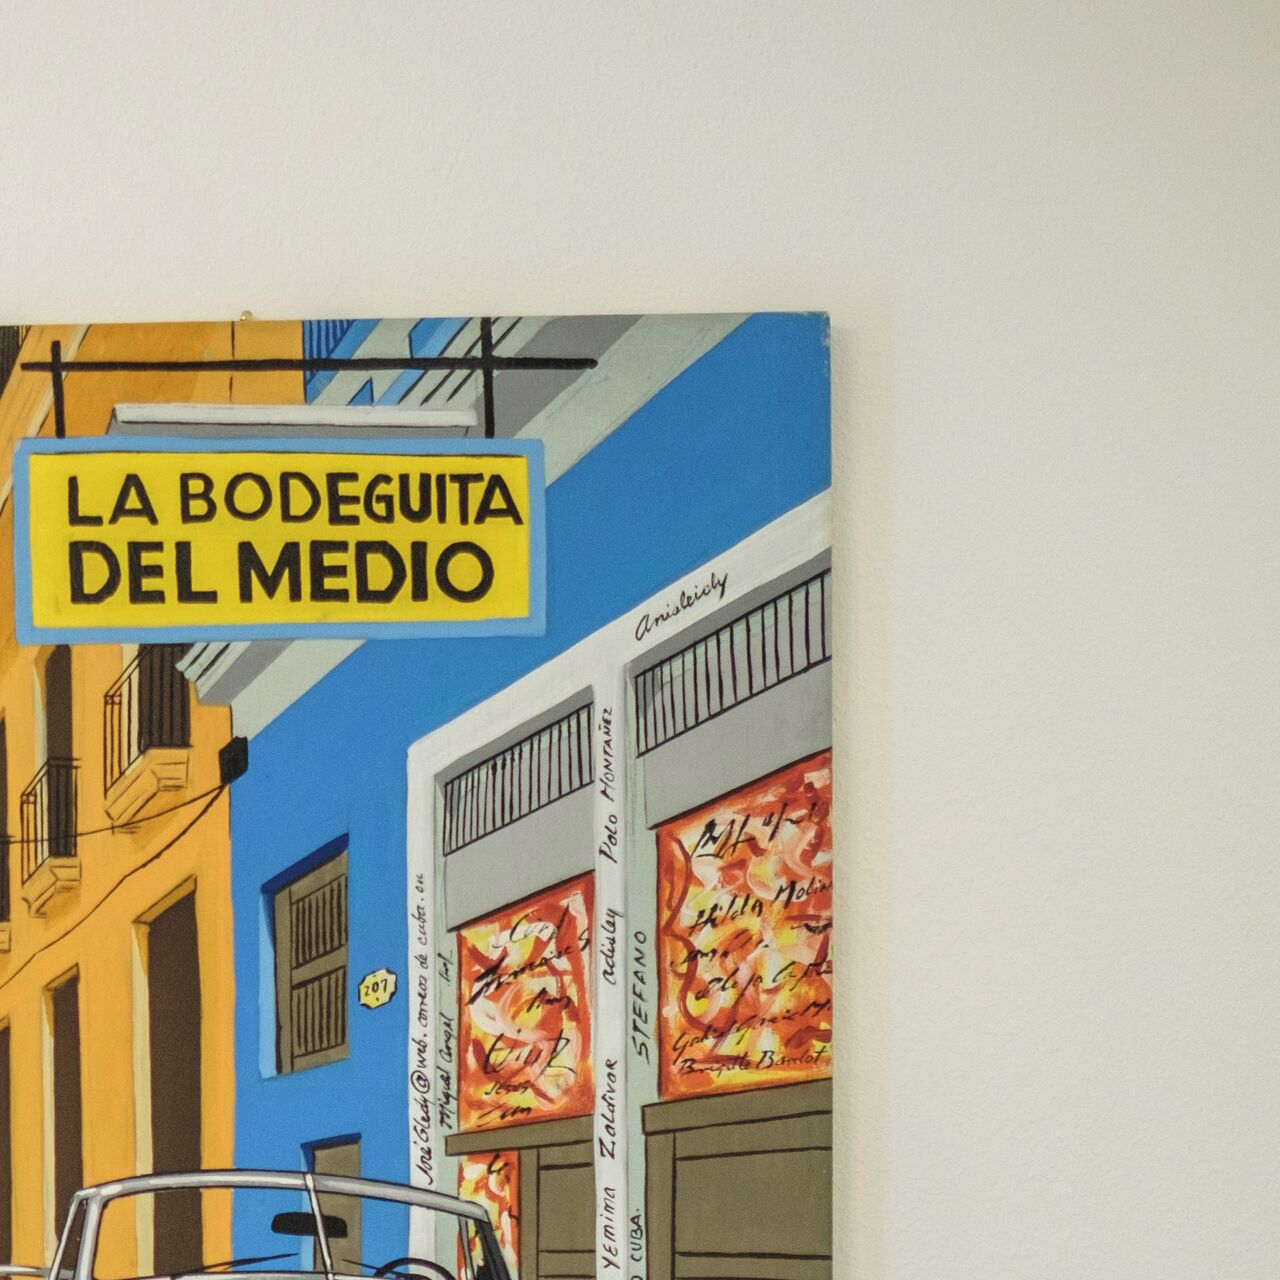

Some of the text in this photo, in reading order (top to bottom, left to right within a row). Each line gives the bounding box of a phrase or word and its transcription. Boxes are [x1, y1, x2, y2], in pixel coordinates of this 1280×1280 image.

[67, 472, 524, 527] LA BODEGUITA
[68, 540, 495, 605] DEL MEDIO
[363, 978, 389, 997] 207
[630, 930, 651, 1065] STEFANO
